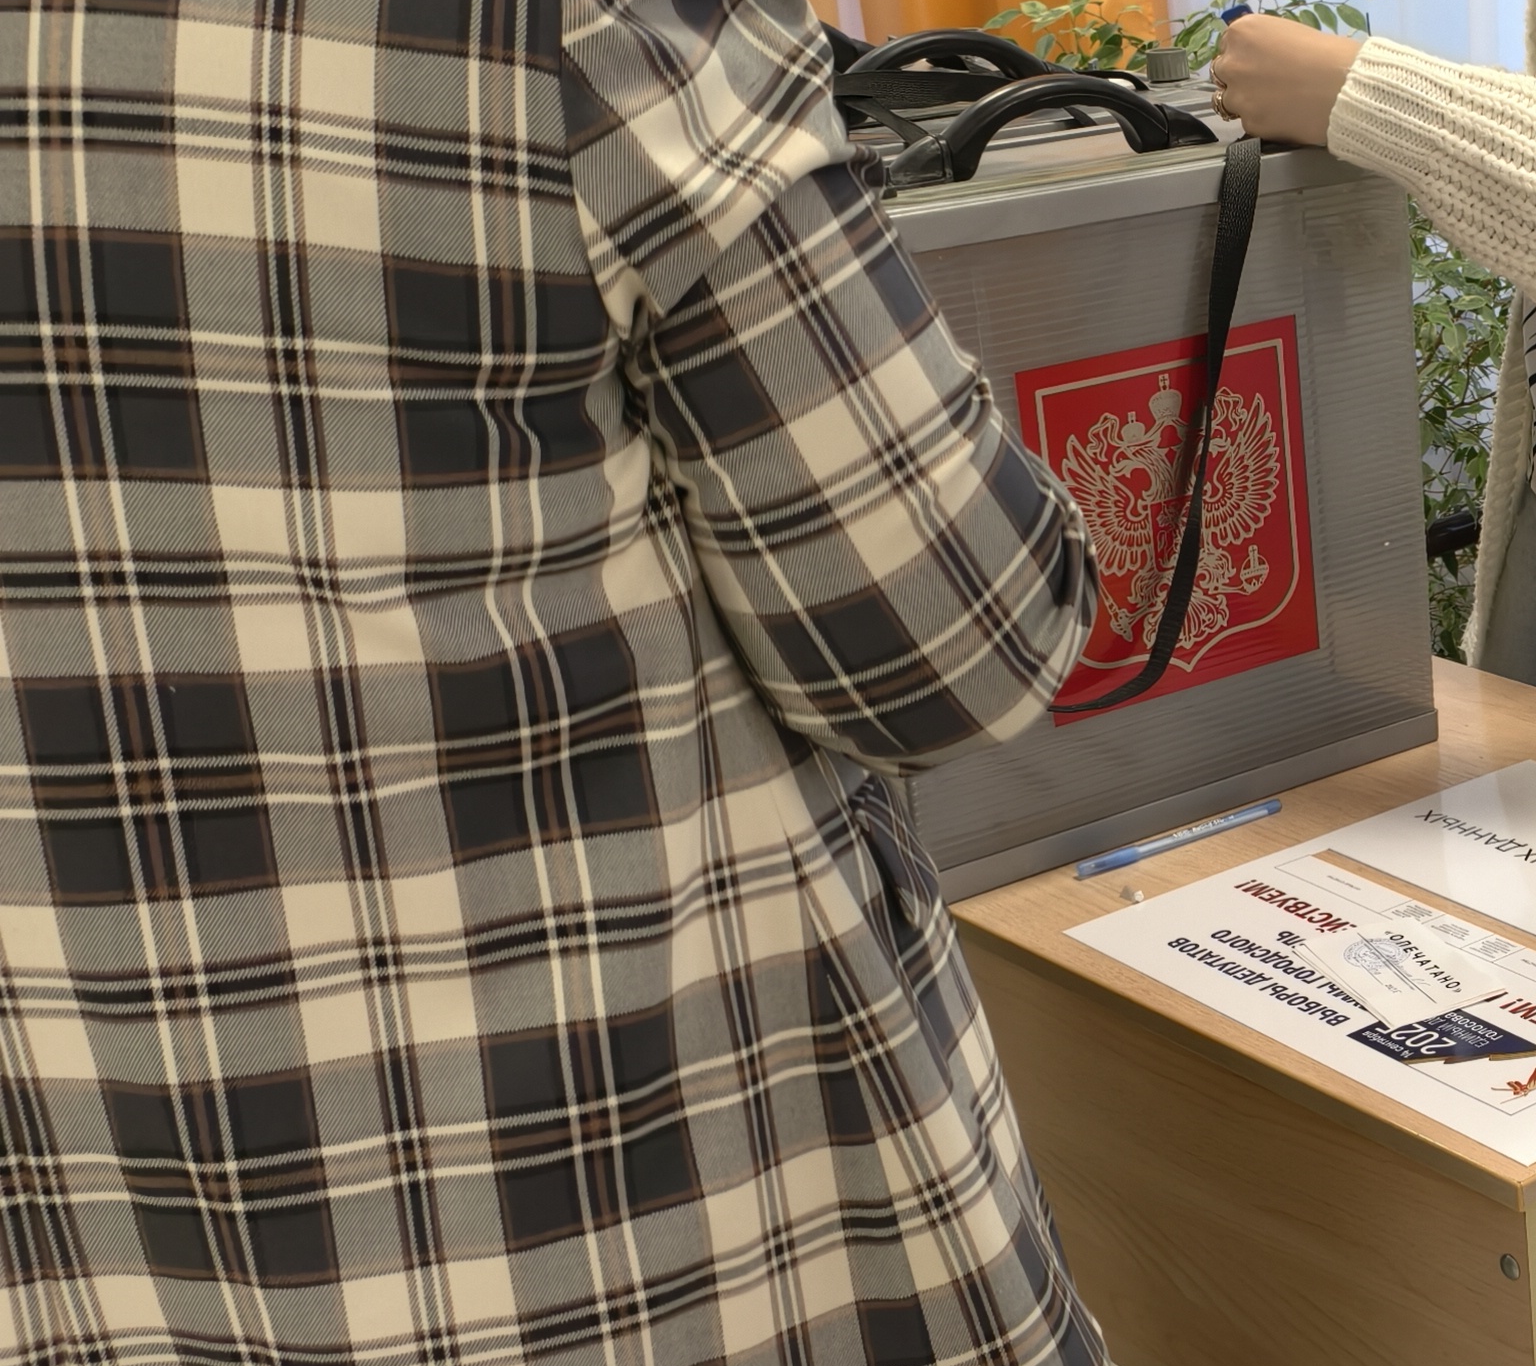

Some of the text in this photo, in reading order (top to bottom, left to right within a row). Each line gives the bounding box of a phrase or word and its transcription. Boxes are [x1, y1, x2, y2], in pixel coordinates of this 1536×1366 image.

[1414, 809, 1528, 853] ДАННЫХ
[1167, 936, 1351, 1026] ВЫБОРЫ ДЕПУТАТОВ
[1210, 929, 1328, 984] ГОРОДСКОГО
[1385, 930, 1463, 994] «ОПЕЧАТАНО»
[1362, 1030, 1402, 1052] сентября
[1435, 1022, 1490, 1048] ЕДИНЫЙ
